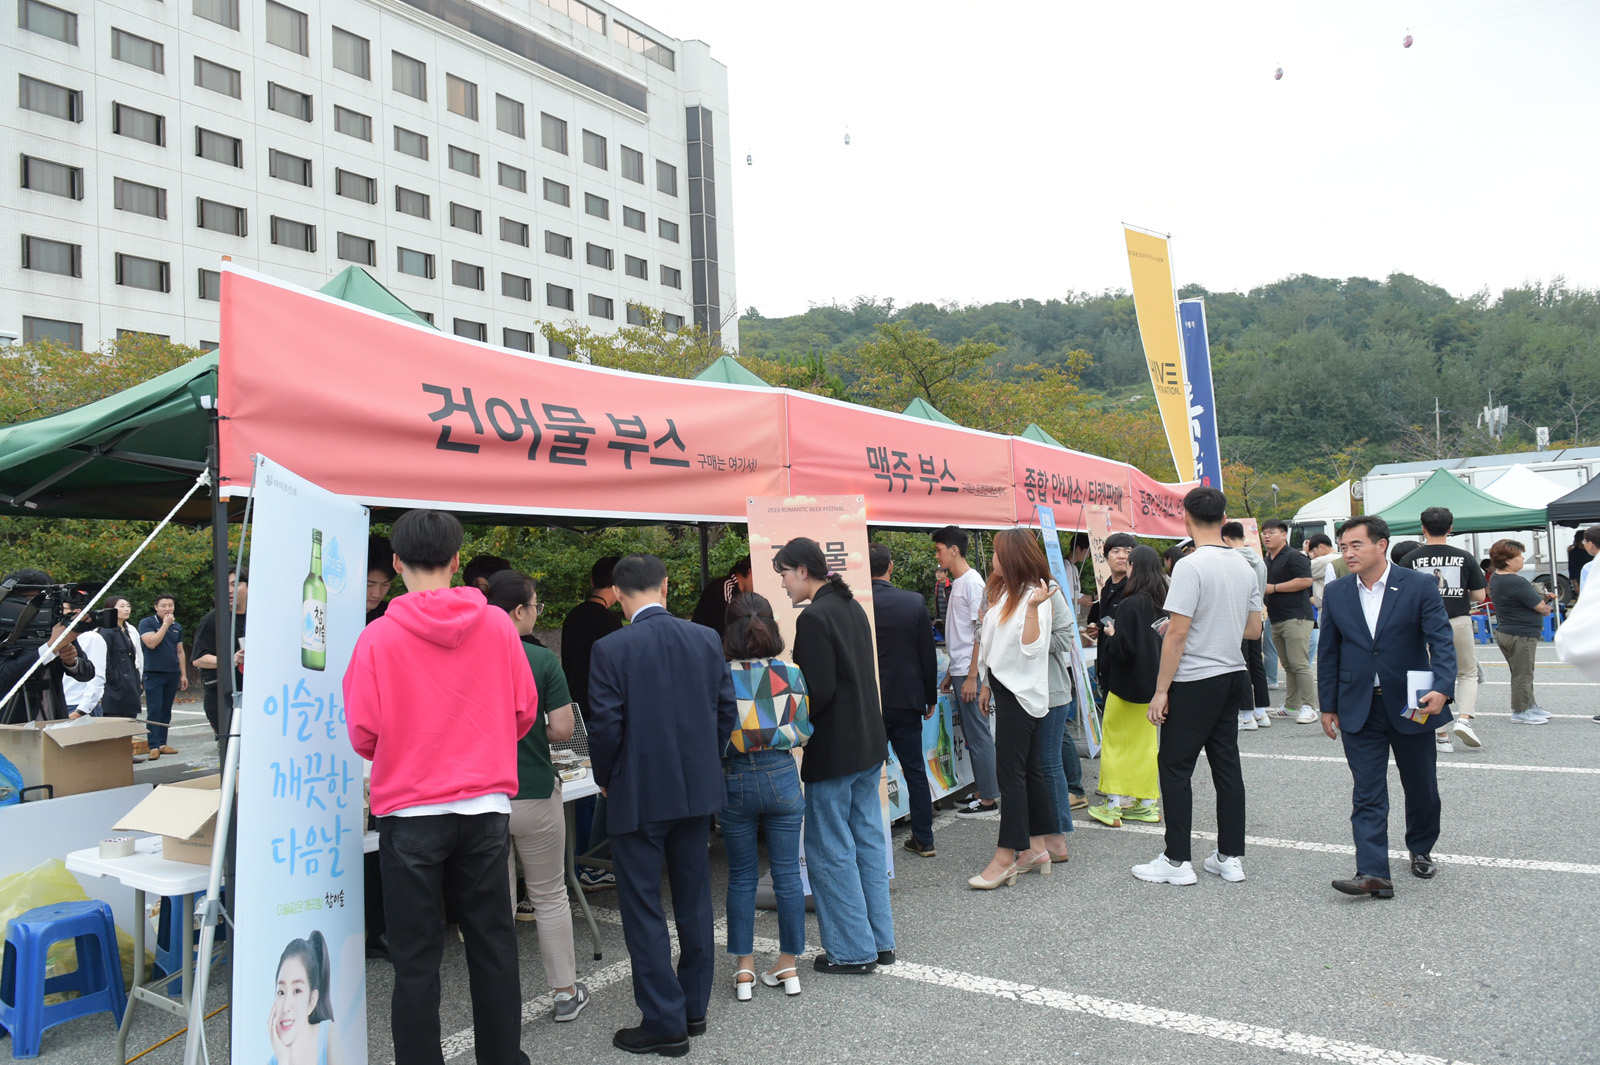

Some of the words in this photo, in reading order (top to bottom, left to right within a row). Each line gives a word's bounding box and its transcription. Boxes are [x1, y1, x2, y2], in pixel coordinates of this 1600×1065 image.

[422, 383, 596, 466] 건어물
[605, 413, 690, 470] 부스
[697, 453, 726, 471] 구매는
[728, 457, 758, 473] 여기서!
[866, 446, 914, 493] 맥주
[918, 453, 959, 495] 부스
[1023, 467, 1049, 503] 종합
[1412, 557, 1429, 569] LIFE
[1431, 556, 1443, 566] ON
[1445, 556, 1464, 567] LIKE
[1447, 587, 1464, 596] NYC
[270, 752, 354, 811] 깨끗한
[271, 814, 352, 878] 다음날
[325, 889, 345, 909] 참이슬
